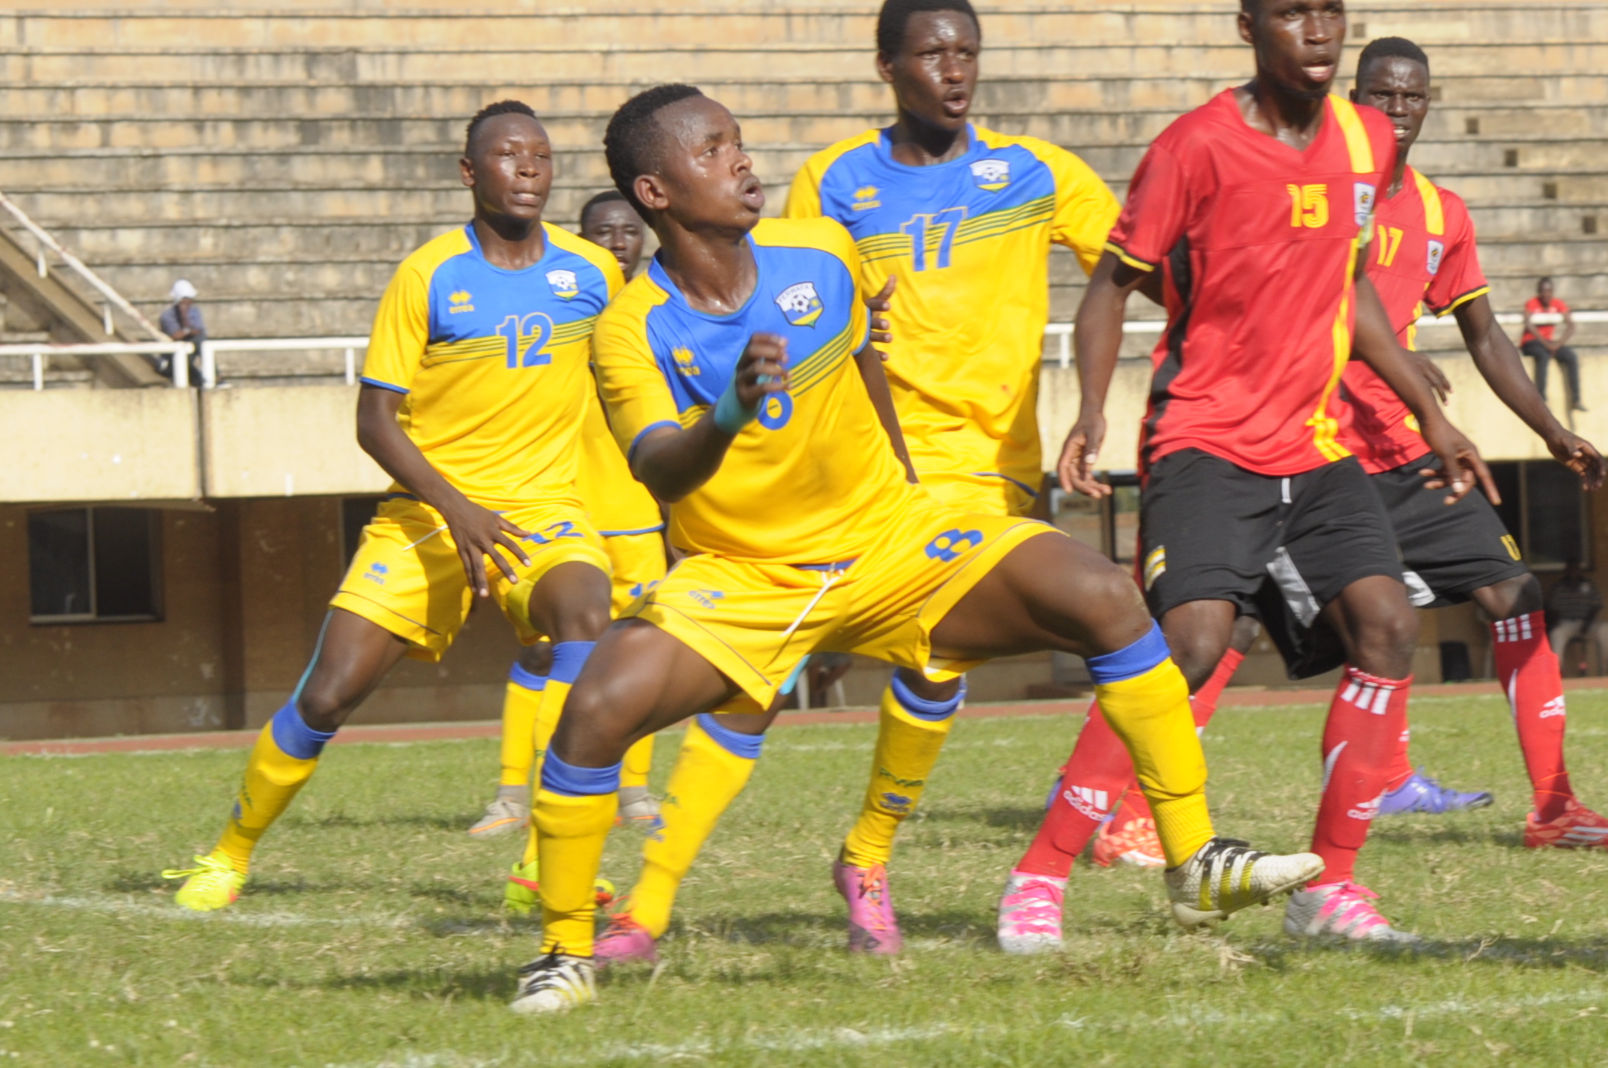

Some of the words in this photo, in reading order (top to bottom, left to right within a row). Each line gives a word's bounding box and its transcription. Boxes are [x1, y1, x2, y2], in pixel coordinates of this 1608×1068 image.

[1286, 183, 1330, 228] 15
[899, 205, 969, 273] 17
[1377, 224, 1404, 267] 17
[495, 311, 553, 369] 12
[924, 528, 984, 563] 8
